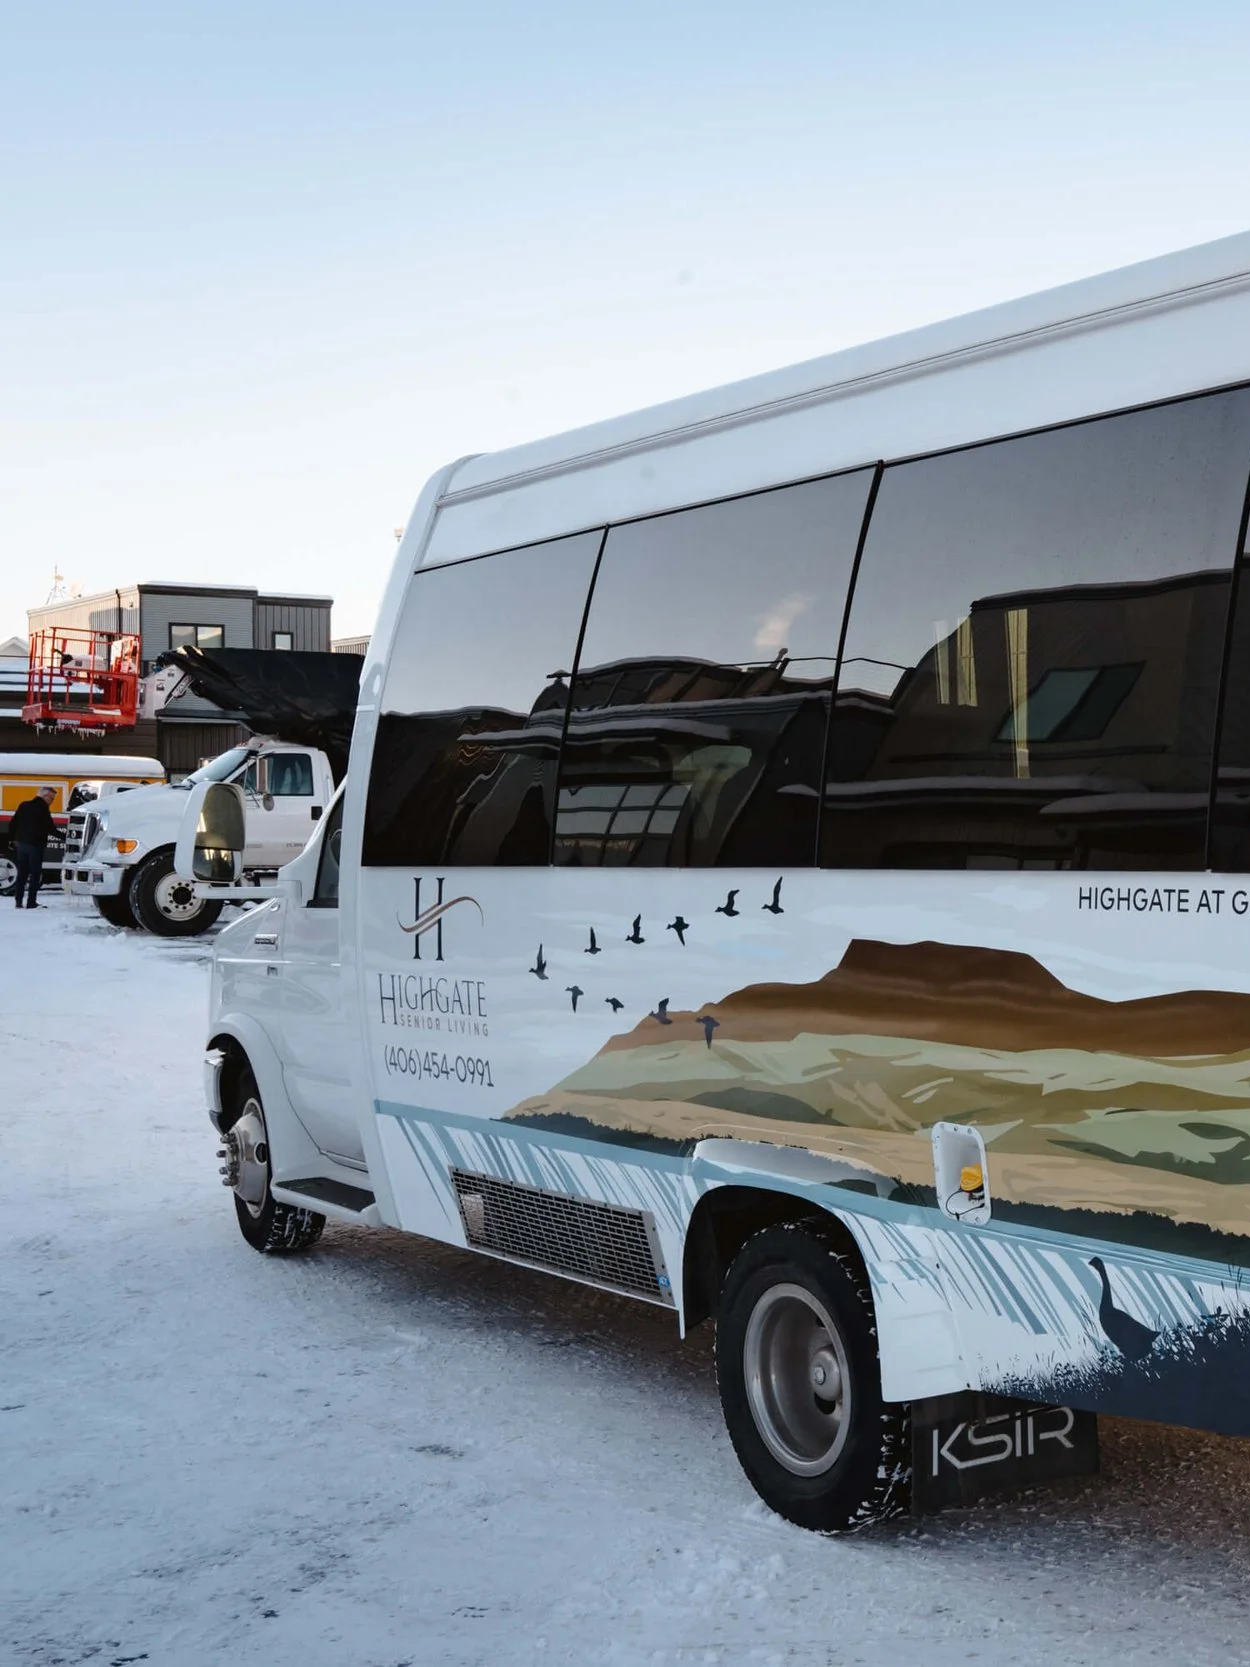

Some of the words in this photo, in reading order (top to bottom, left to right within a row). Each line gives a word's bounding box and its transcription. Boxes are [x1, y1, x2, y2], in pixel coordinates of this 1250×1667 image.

[1078, 886, 1190, 913] HIGHGATE
[1196, 889, 1225, 914] AT
[378, 973, 487, 1025] HIGHGATE
[400, 1014, 441, 1031] SENIOR
[448, 1019, 489, 1037] LIVING
[384, 1045, 494, 1087] (406)454-0991
